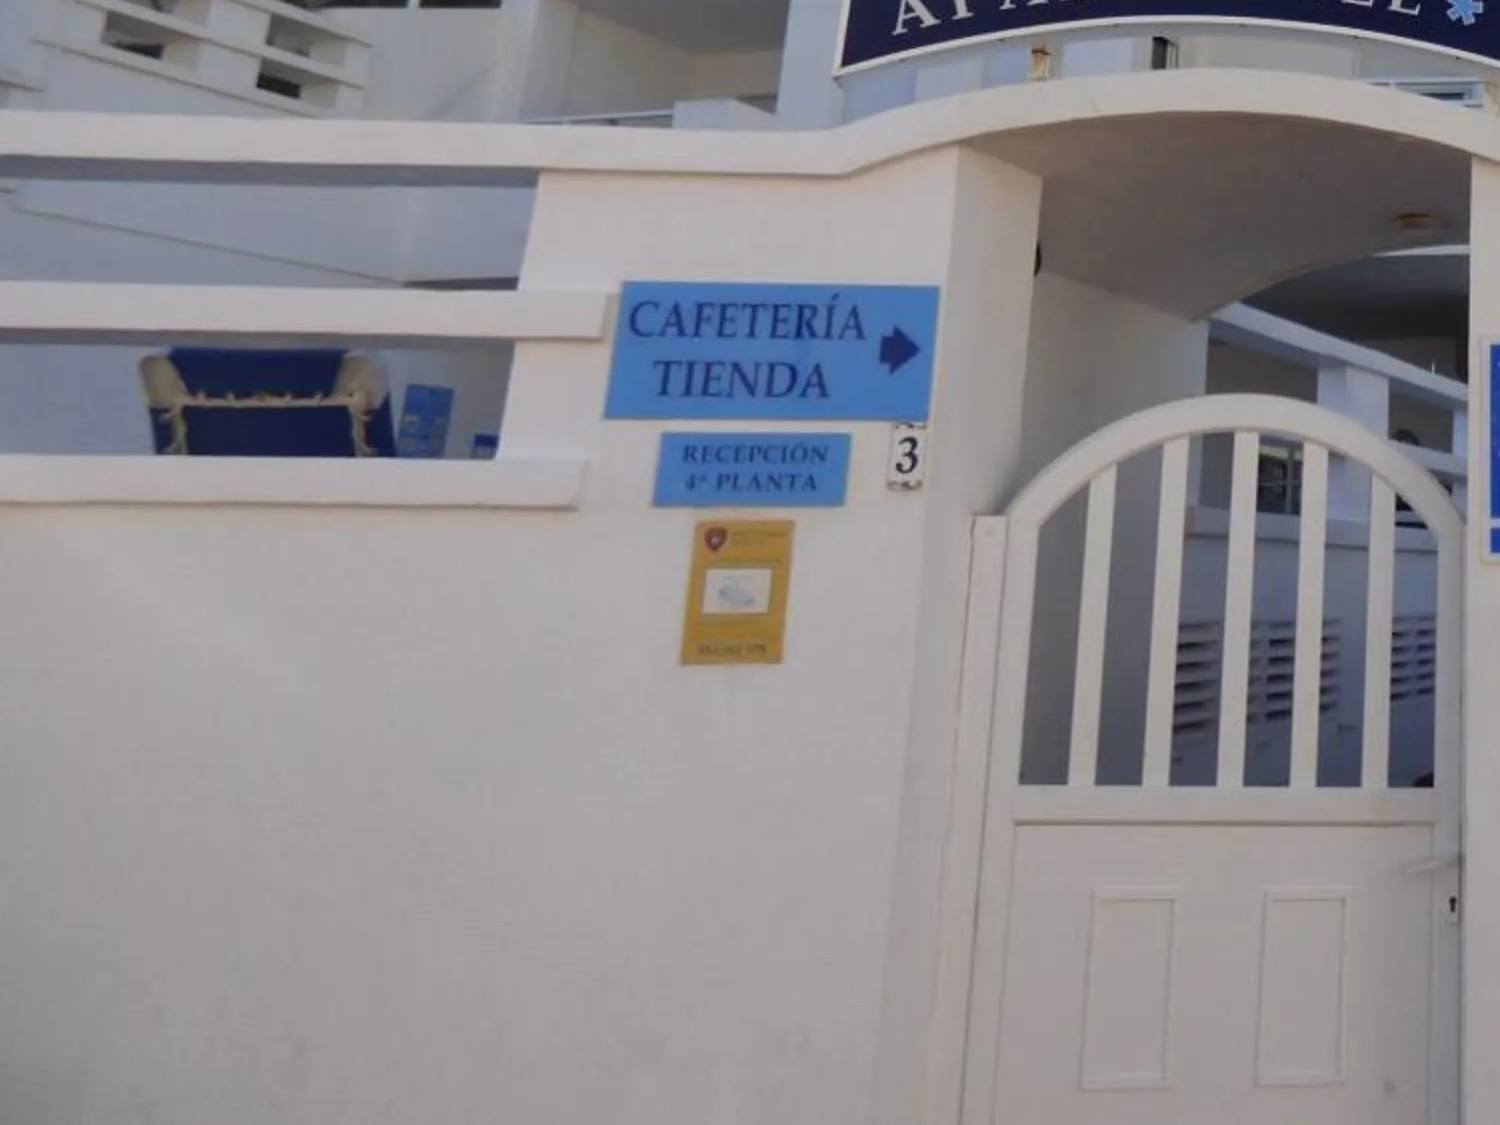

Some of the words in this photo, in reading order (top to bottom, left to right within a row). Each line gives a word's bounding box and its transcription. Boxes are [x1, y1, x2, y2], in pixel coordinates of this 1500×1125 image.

[628, 293, 867, 341] CAFETERÍA
[652, 360, 831, 399] TIENDA
[682, 442, 829, 464] RECEPCIÓN
[894, 435, 919, 475] 3
[715, 472, 818, 492] PLANTA
